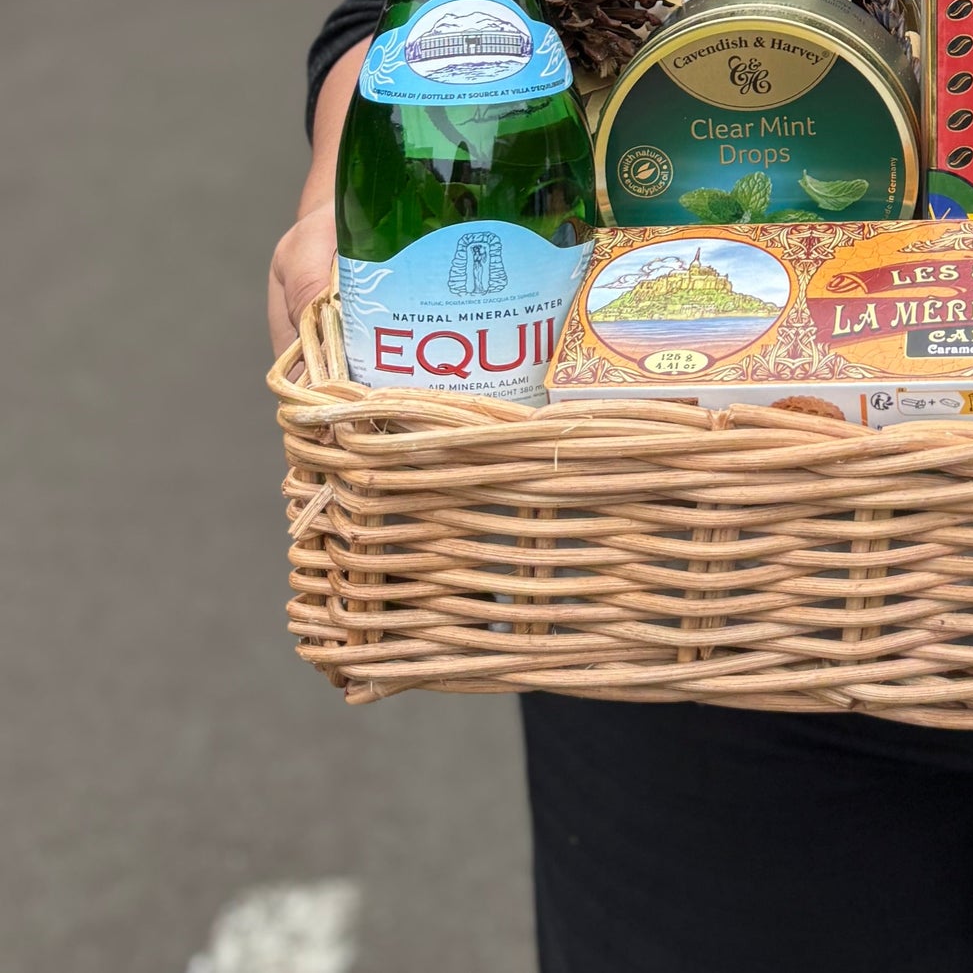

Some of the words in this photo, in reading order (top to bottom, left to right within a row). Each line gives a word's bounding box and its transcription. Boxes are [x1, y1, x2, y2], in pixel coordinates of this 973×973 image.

[673, 37, 748, 69] Cavendish
[753, 37, 765, 48] &
[770, 38, 824, 65] Harvey
[468, 91, 499, 99] SOURCE
[511, 87, 531, 95] VILLA
[690, 119, 753, 140] Clear
[760, 116, 816, 138] Mint
[623, 154, 636, 172] with
[635, 149, 667, 165] natural
[719, 144, 790, 168] Drops
[661, 171, 669, 181] oil
[887, 156, 898, 194] Germany
[625, 179, 665, 196] eucalyptus
[886, 195, 895, 203] in
[891, 265, 959, 286] LES
[392, 312, 452, 323] NATURAL
[459, 308, 519, 321] MINERAL
[525, 298, 563, 314] WATER
[831, 303, 880, 337] LA
[661, 353, 681, 361] 125
[685, 354, 693, 362] g
[449, 381, 496, 391] MINERAL
[499, 376, 529, 388] ALAMI
